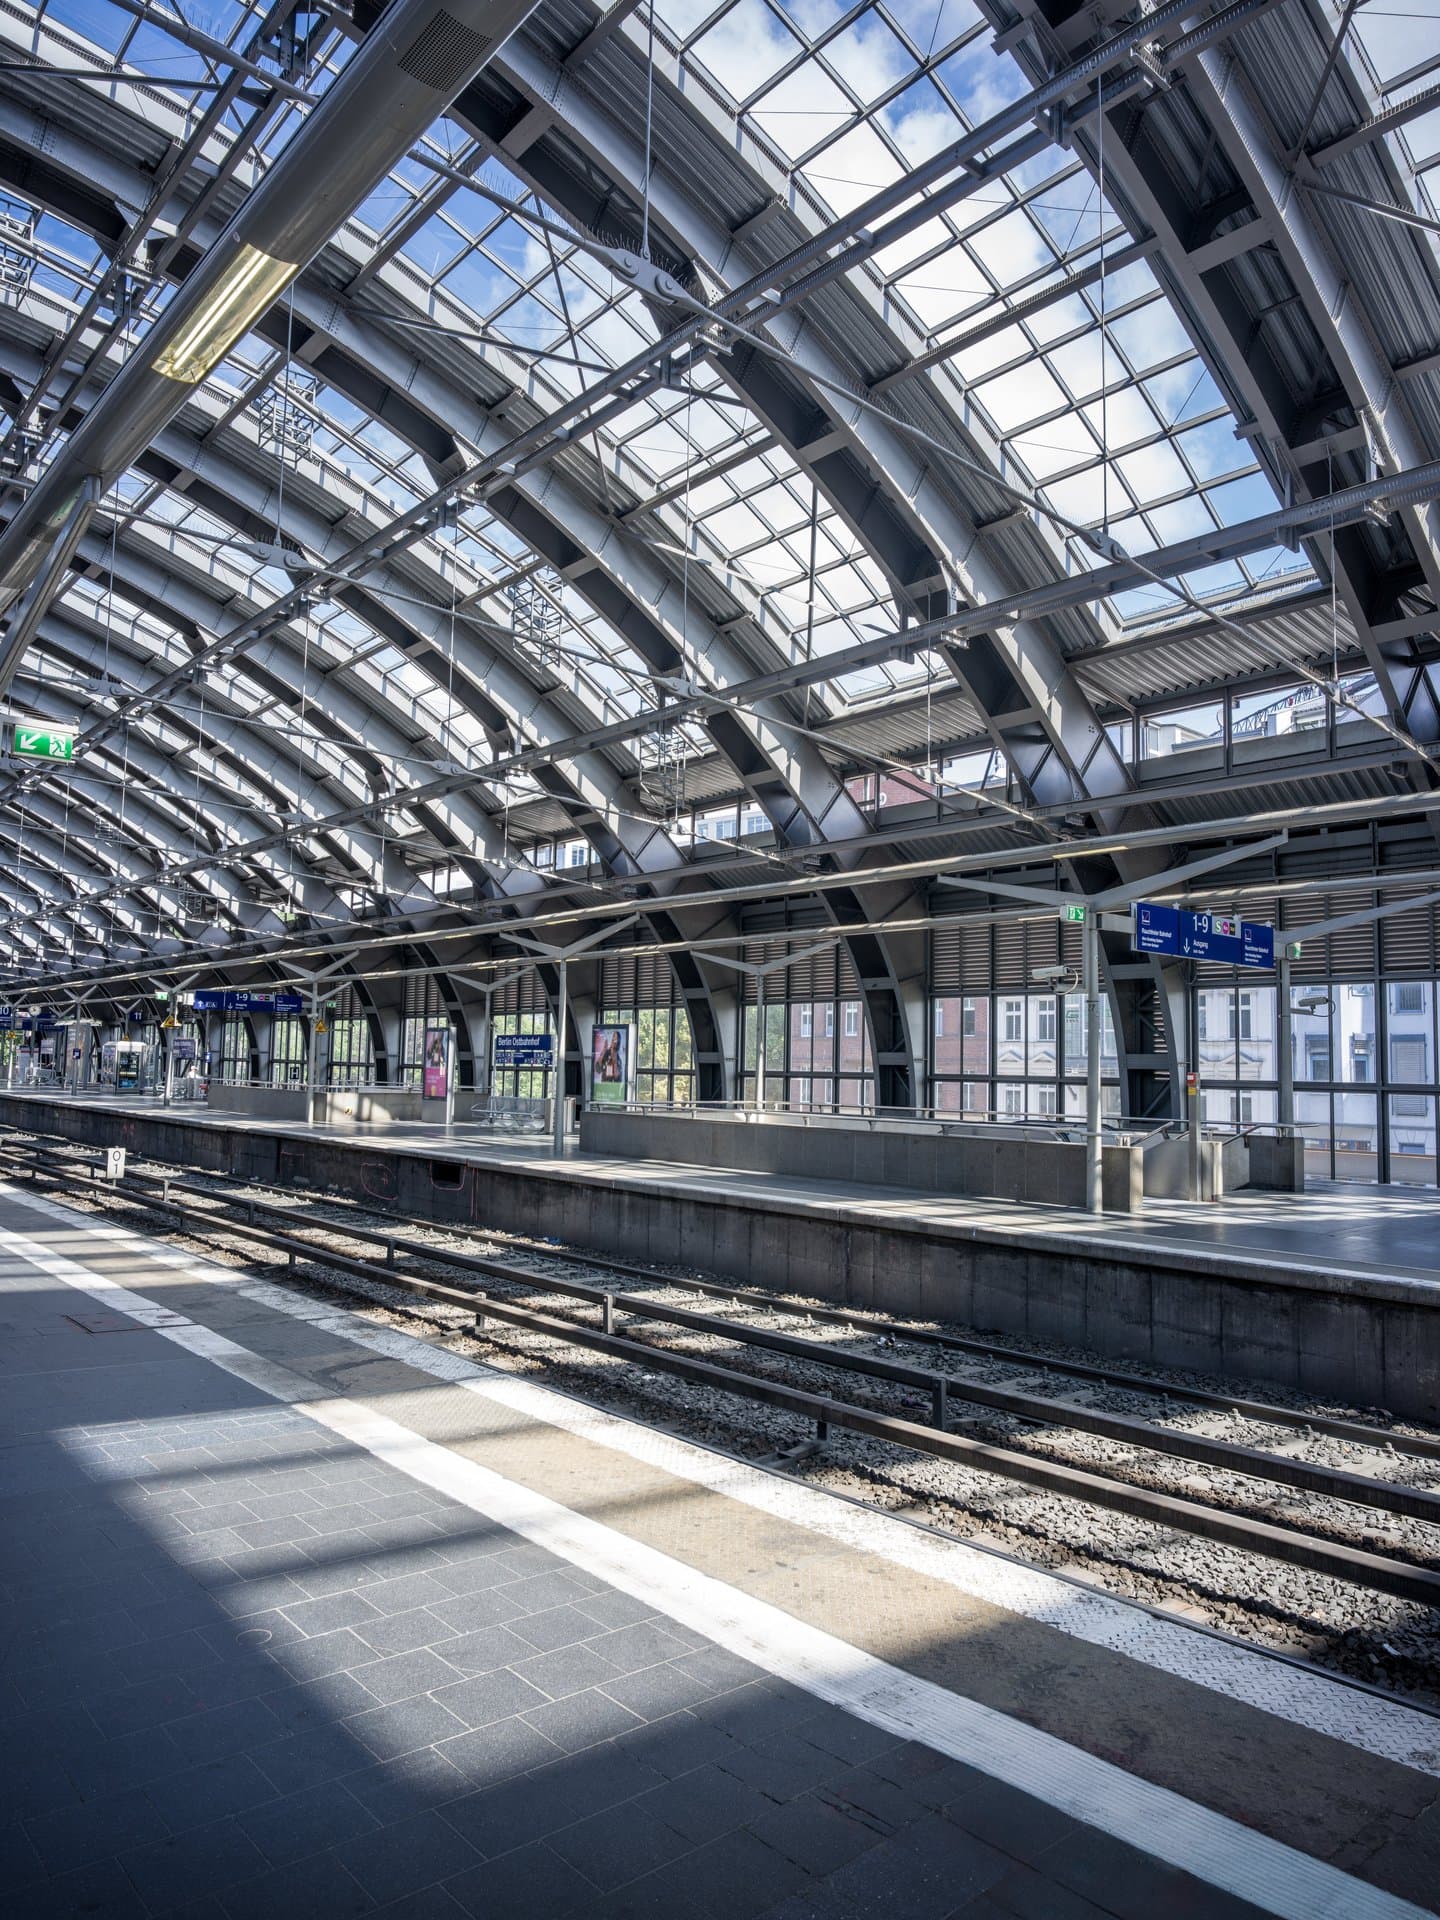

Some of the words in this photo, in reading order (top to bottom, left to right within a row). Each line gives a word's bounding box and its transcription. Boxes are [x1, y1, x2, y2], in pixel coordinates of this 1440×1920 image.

[1193, 914, 1209, 933] 1-9
[1193, 939, 1209, 949] Ausgang
[235, 993, 248, 1001] 1-9
[134, 1012, 142, 1020] 11
[498, 1037, 512, 1046] Berlin
[512, 1036, 540, 1046] Ostbahnhof
[290, 1068, 299, 1079] H
